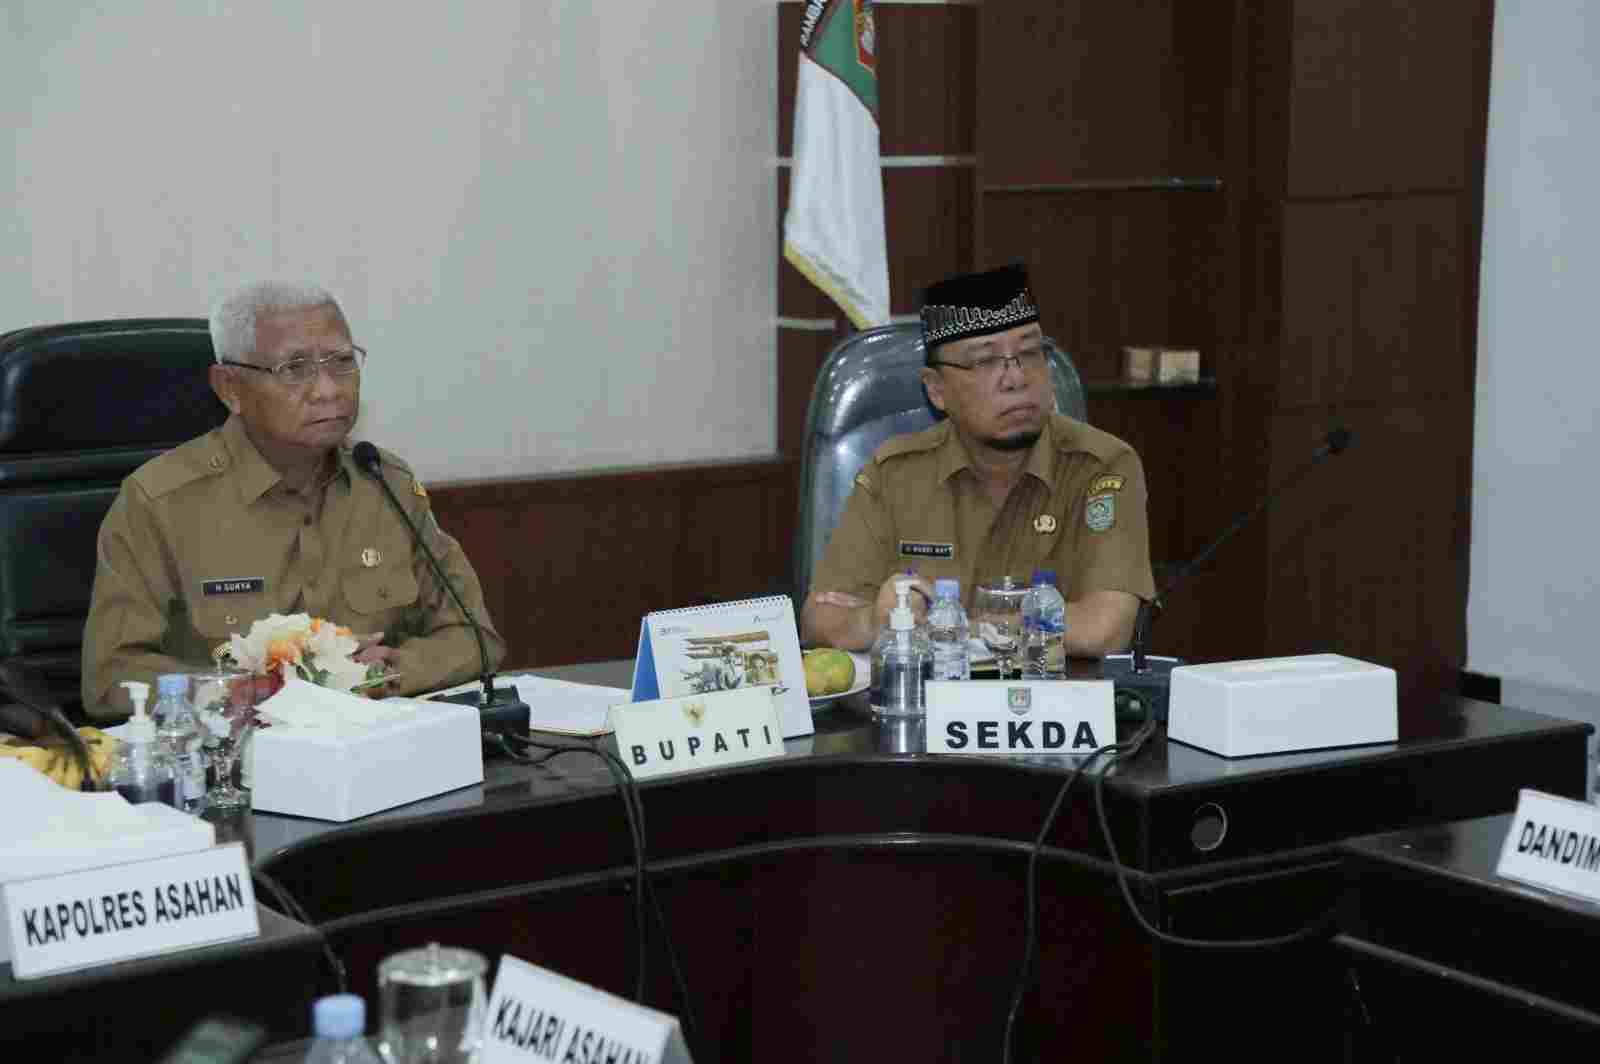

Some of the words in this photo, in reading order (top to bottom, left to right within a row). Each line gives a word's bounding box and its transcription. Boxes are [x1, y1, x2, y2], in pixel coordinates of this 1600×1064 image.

[631, 725, 772, 766] BUPATI
[945, 720, 1098, 749] SEKDA
[23, 889, 147, 947] KAPOLRES
[154, 872, 245, 925] ASAHAN
[491, 995, 567, 1062] KAJARI
